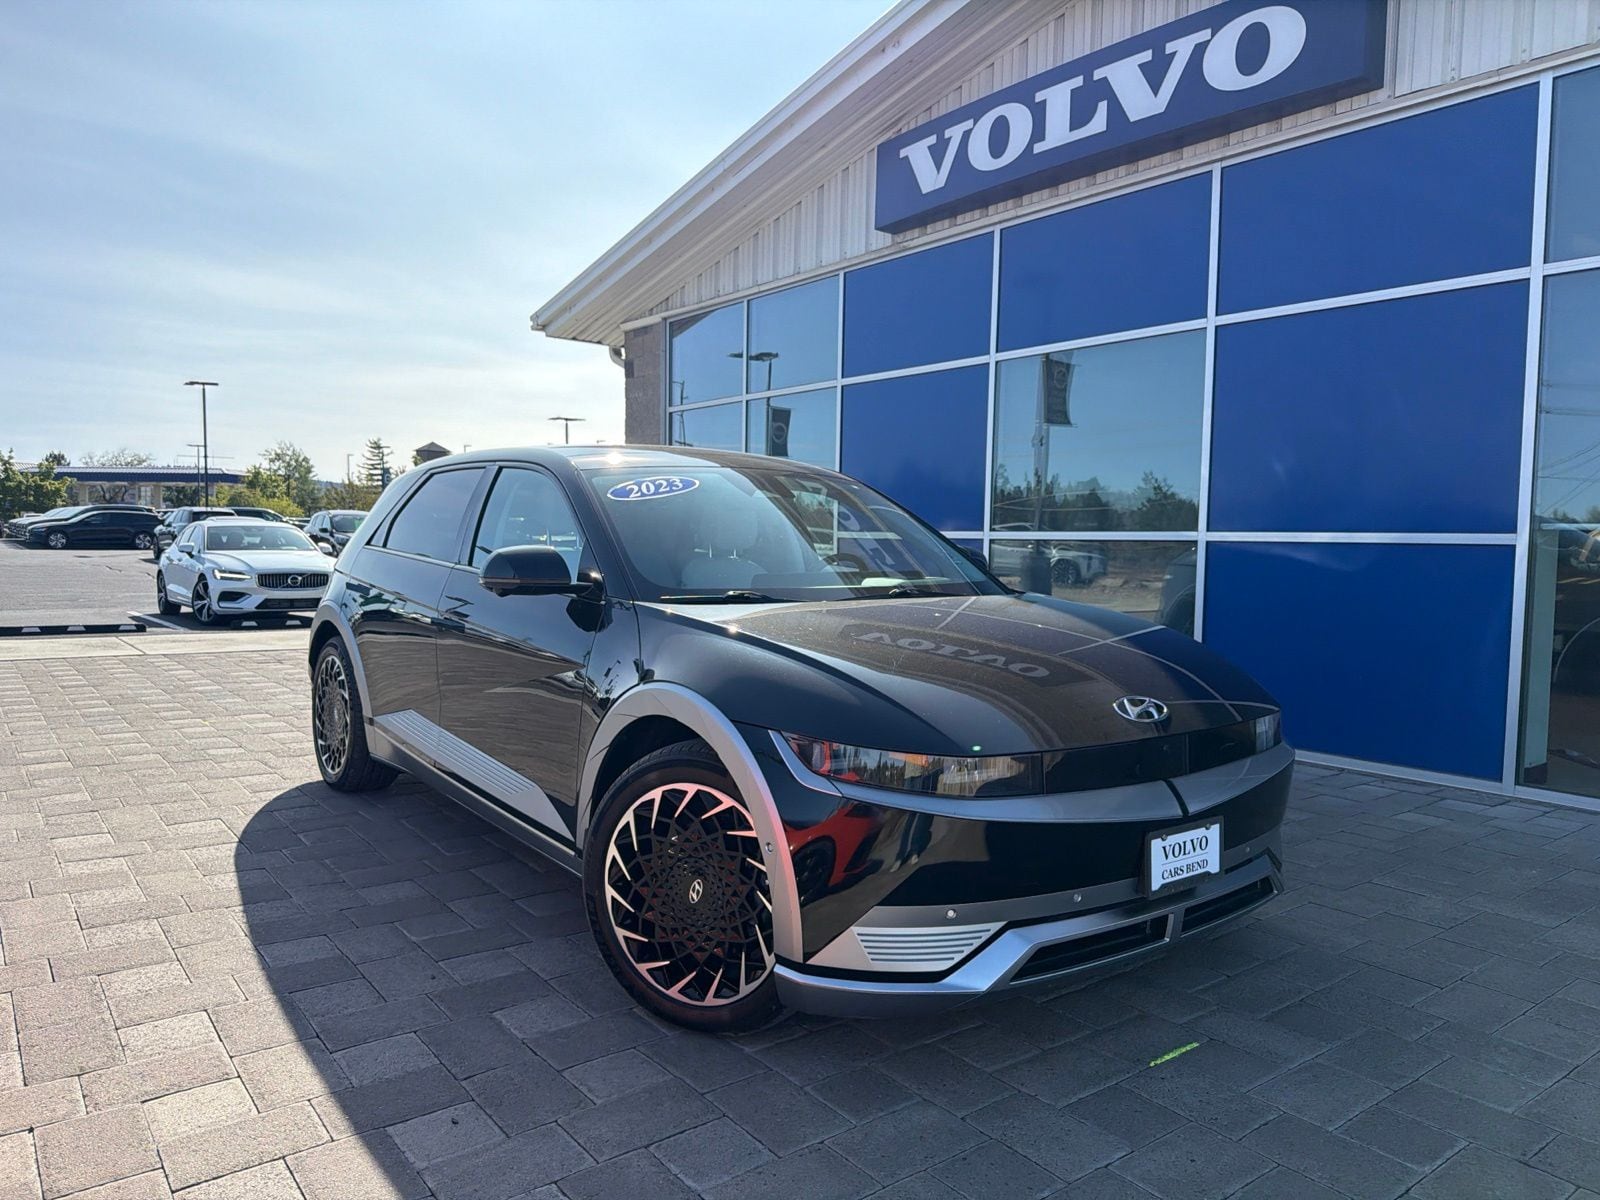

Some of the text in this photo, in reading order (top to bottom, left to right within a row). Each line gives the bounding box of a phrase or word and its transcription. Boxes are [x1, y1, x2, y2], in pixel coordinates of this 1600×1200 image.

[899, 5, 1307, 195] VOLVO
[626, 478, 684, 498] 2023
[1162, 835, 1209, 861] VOLVO
[1161, 858, 1209, 881] CARS BEND
